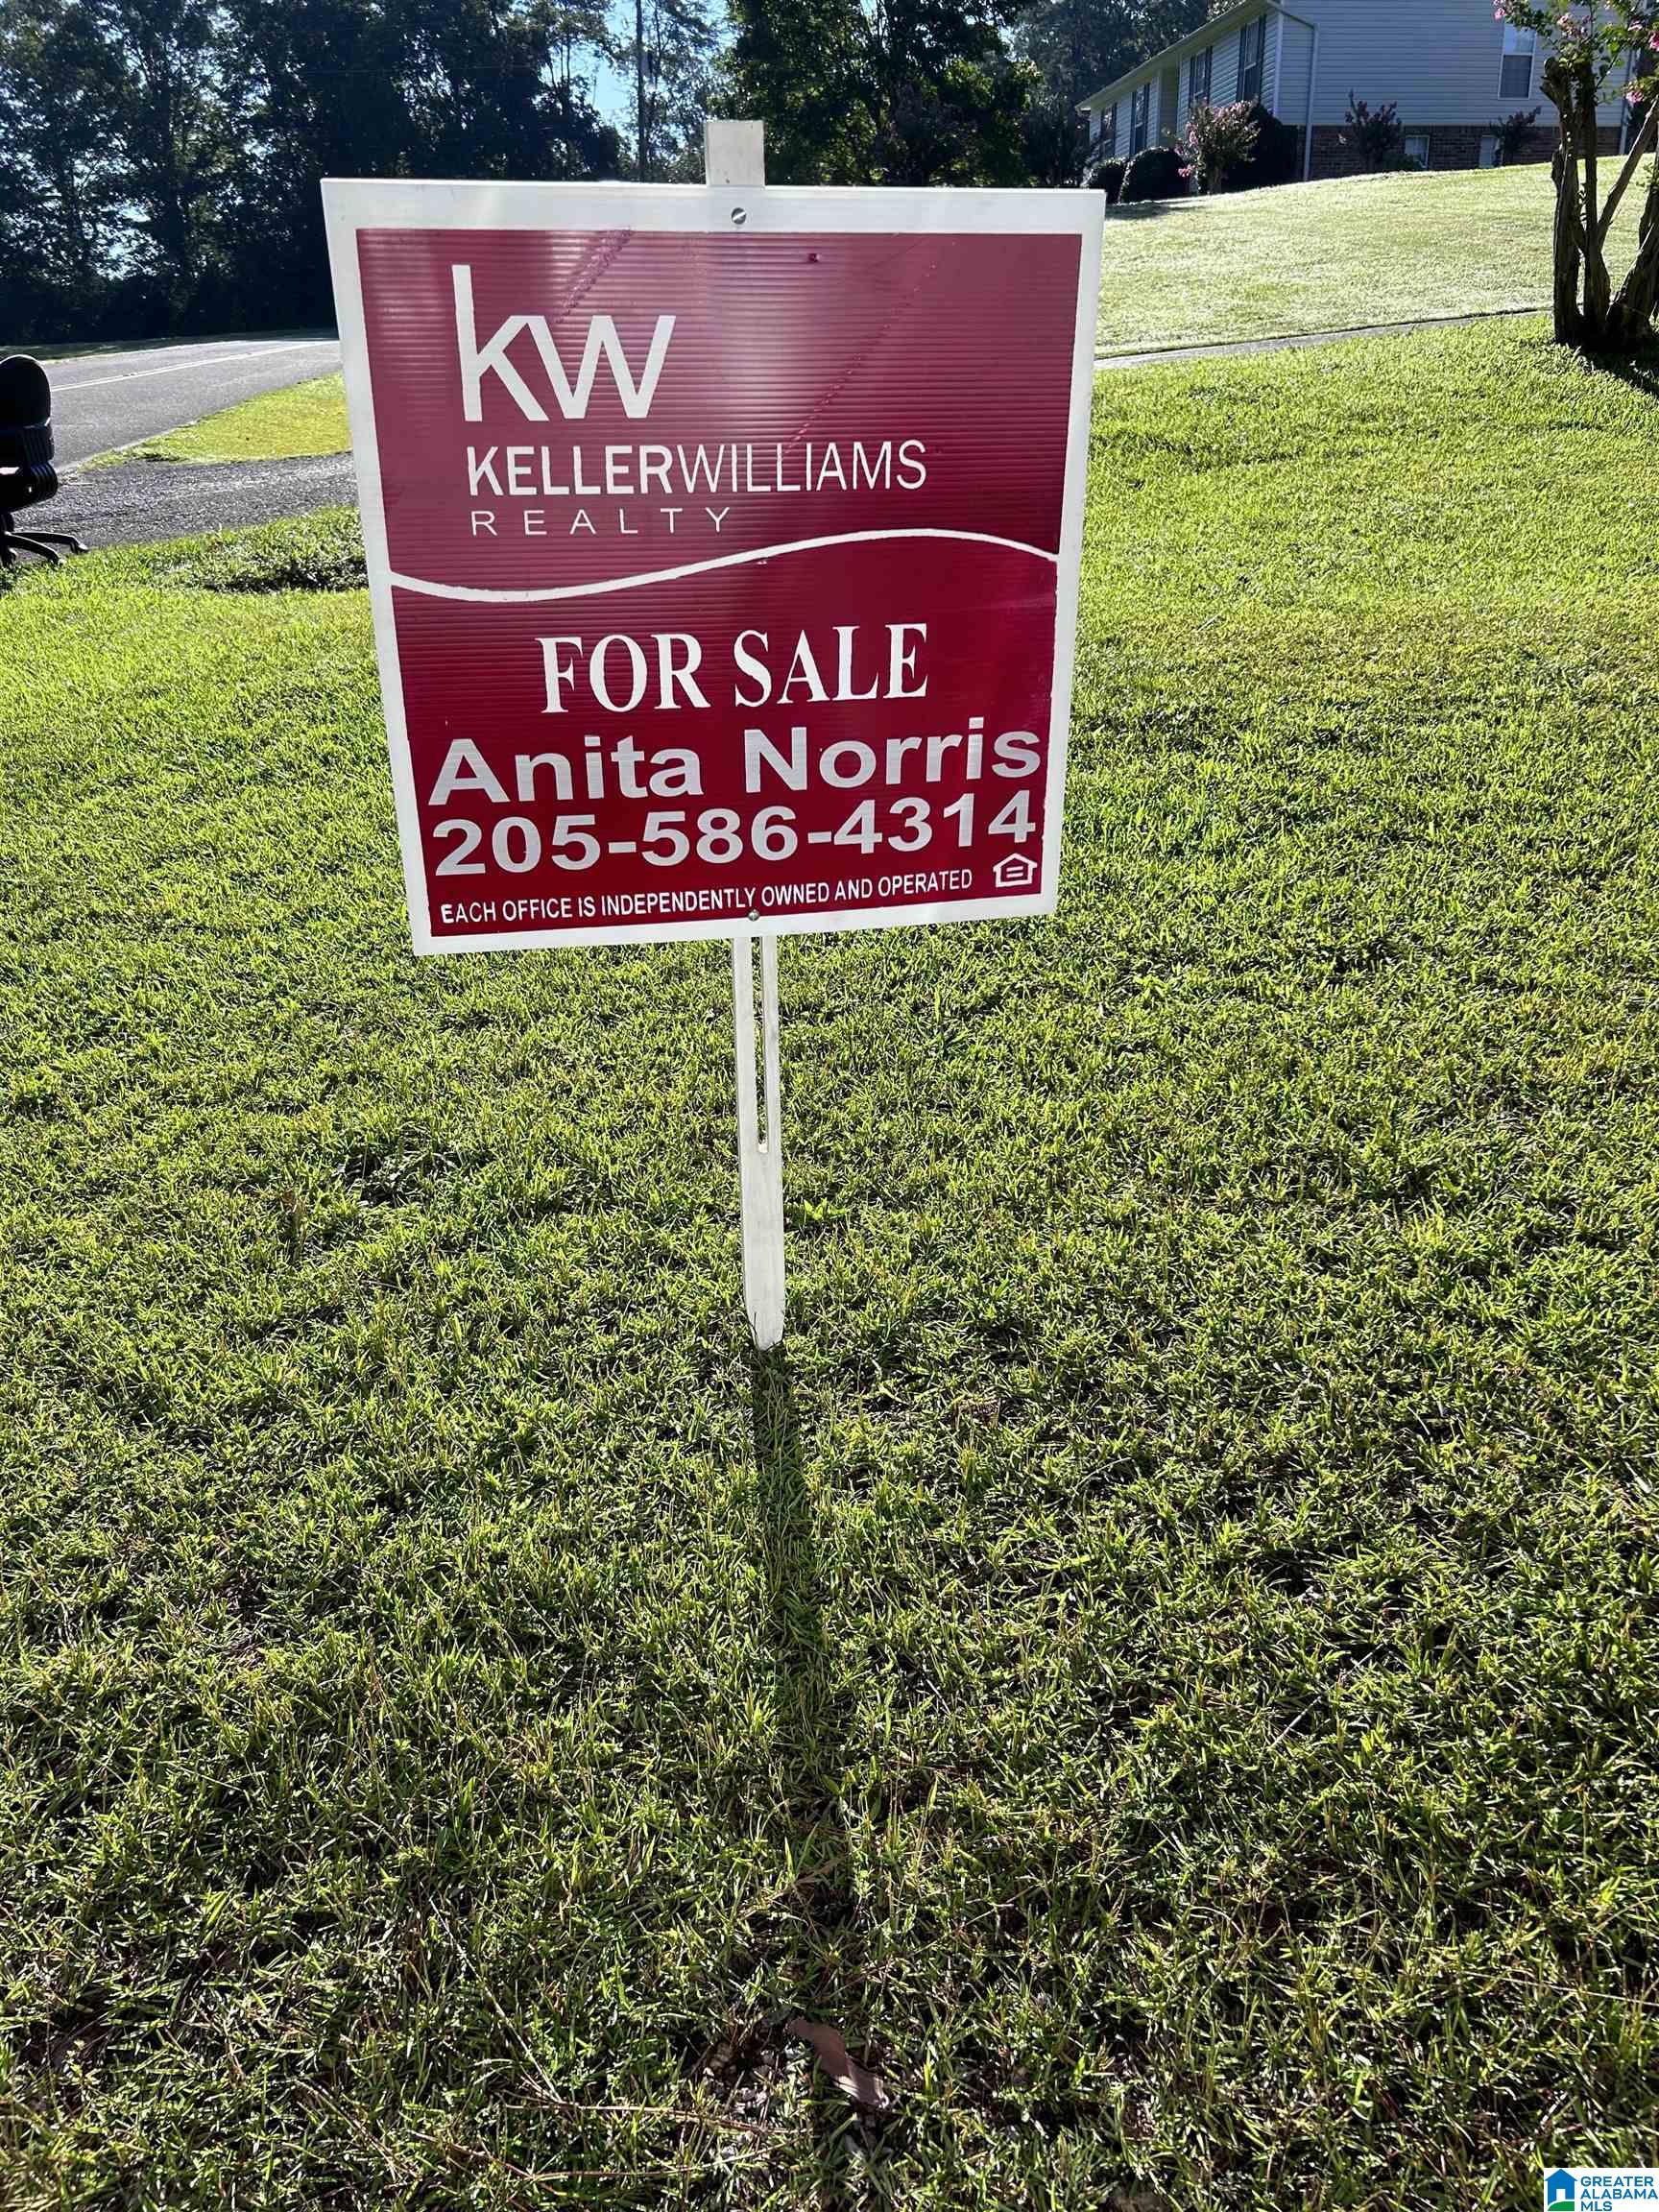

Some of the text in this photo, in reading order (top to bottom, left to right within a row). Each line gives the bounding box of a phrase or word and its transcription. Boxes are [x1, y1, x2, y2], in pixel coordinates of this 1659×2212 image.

[470, 506, 732, 536] REALTY
[535, 622, 929, 714] FOR SALE
[427, 717, 1042, 806] Anita Norris
[434, 789, 1038, 877] 205-586-4314
[441, 868, 974, 924] EACH OFFICE IS INDEPENDENTLY OWNED AND OPERATED
